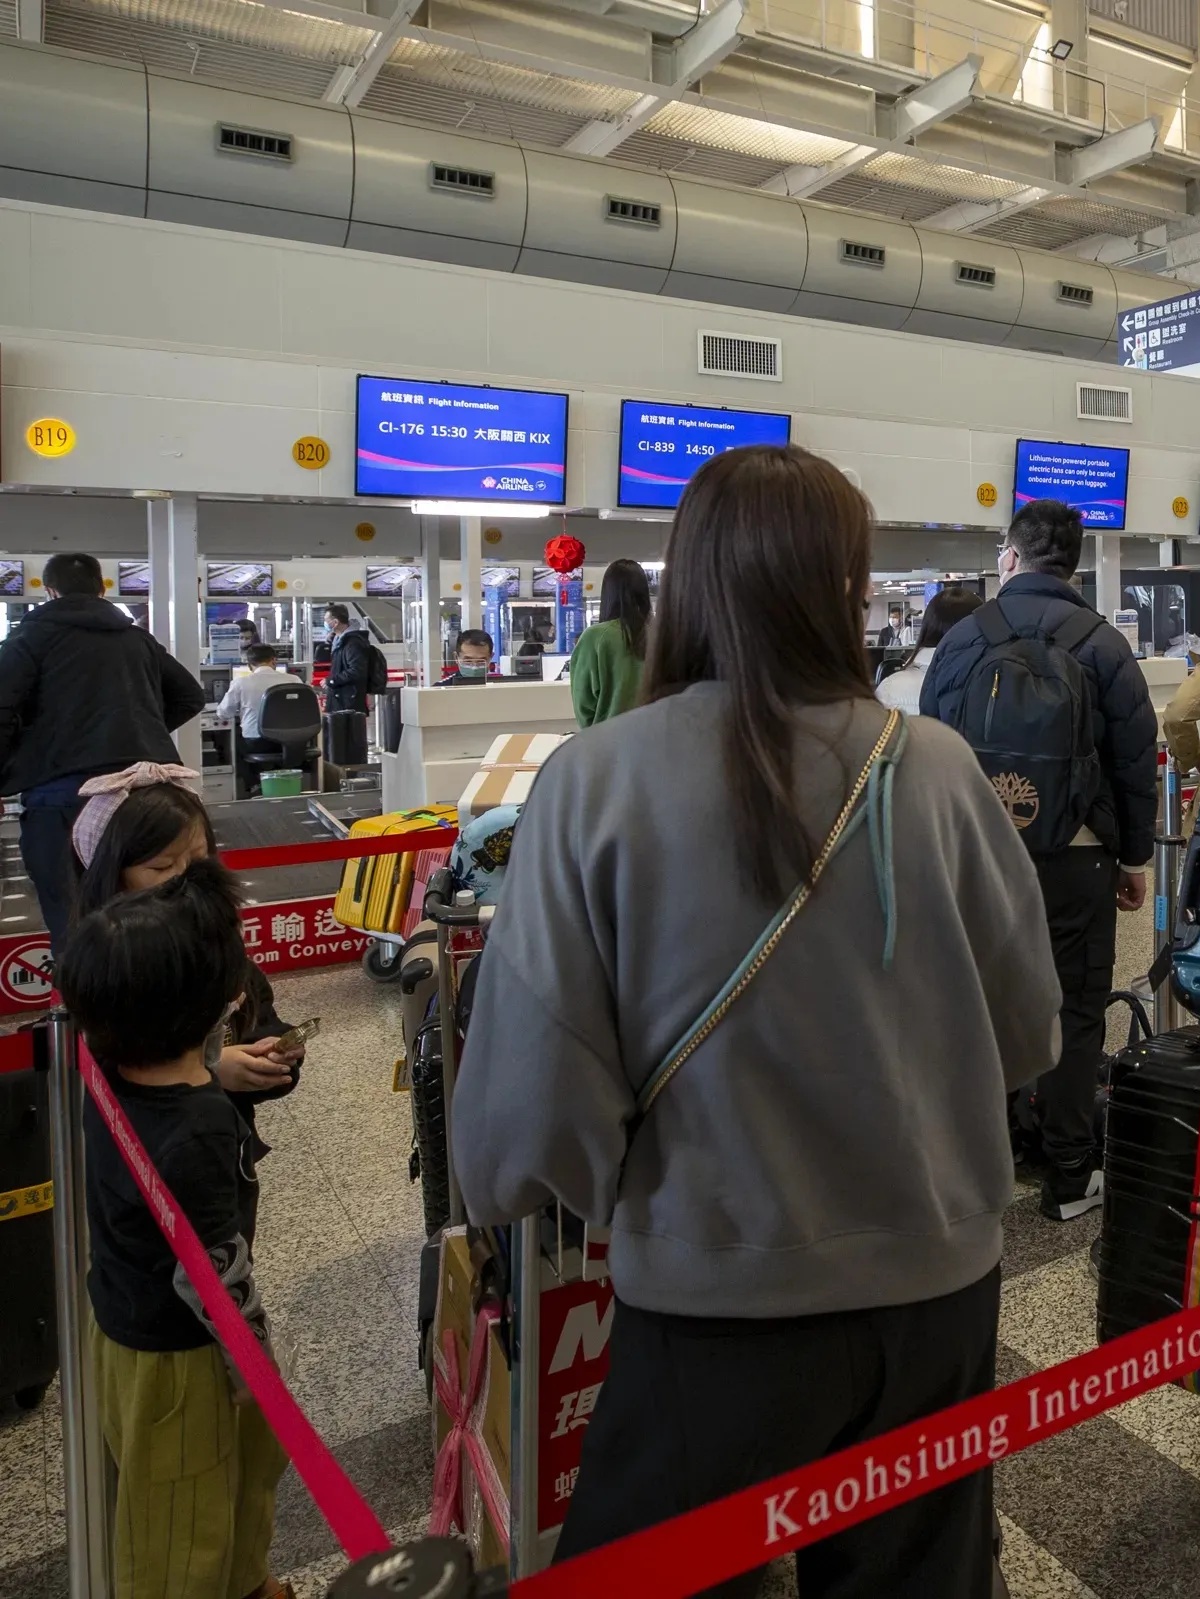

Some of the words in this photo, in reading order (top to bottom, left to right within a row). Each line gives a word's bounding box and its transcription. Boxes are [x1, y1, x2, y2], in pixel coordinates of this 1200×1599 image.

[1148, 319, 1159, 327] Group
[1160, 314, 1177, 323] Assembly
[1162, 336, 1183, 345] Restroom
[1148, 360, 1172, 370] Restaurant
[380, 391, 424, 405] 航班資訊
[428, 397, 452, 408] Flight
[453, 399, 499, 411] Information
[640, 414, 675, 426] 航班資訊
[678, 419, 697, 428] Flight
[698, 421, 735, 431] Information
[34, 426, 67, 447] B19
[378, 421, 424, 436] CI-176
[431, 425, 467, 439] 15:30
[474, 428, 526, 443] 大阪關西
[529, 432, 550, 445] KIX
[297, 443, 325, 462] B20
[638, 440, 675, 453] CI-839
[685, 444, 715, 456] 14:50
[1029, 454, 1061, 463] Lithium-ion
[1063, 457, 1086, 466] powered
[1087, 459, 1109, 467] portable
[1028, 465, 1050, 473] electric
[1076, 468, 1087, 477] only
[1089, 469, 1096, 477] be
[1097, 470, 1115, 478] carried
[496, 482, 534, 492] AIRLINES
[501, 476, 528, 485] CHINA
[1028, 475, 1052, 484] onboard
[1061, 479, 1084, 487] carry-on
[979, 487, 995, 502] B22
[1175, 500, 1188, 514] B23
[289, 936, 377, 959] Conveyo
[763, 1413, 1010, 1547] Kaohsiung
